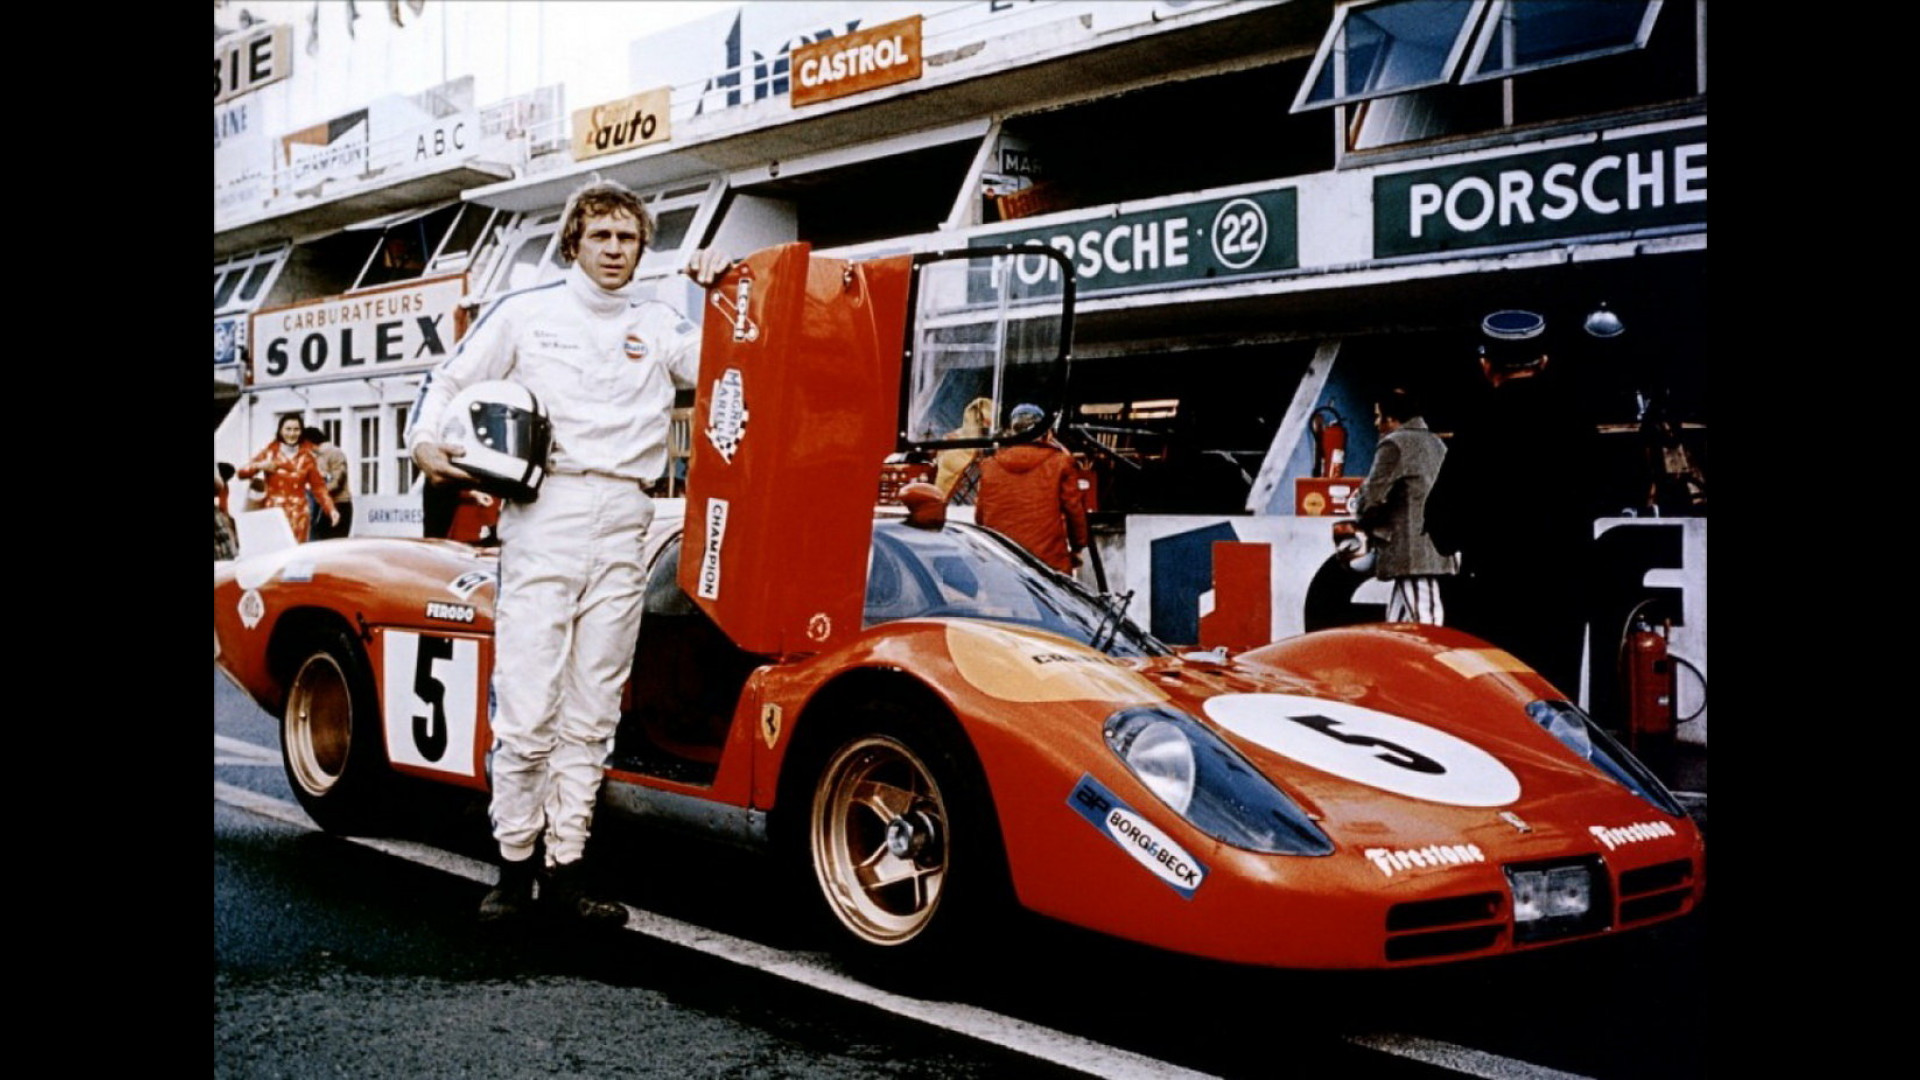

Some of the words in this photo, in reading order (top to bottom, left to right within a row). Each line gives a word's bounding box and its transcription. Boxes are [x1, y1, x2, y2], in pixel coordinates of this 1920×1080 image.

[801, 36, 908, 87] CASTROL
[595, 110, 656, 150] auto
[1410, 142, 1706, 237] PORSCHE
[1222, 210, 1260, 255] 22
[283, 293, 423, 332] CARBURATEURS
[266, 313, 446, 376] SOLEX
[704, 504, 724, 595] CHAMPION
[426, 602, 474, 622] FERODO
[412, 632, 453, 762] 5
[1286, 714, 1447, 775] 5
[1365, 843, 1485, 876] Firestone
[1589, 820, 1676, 852] Firestone
